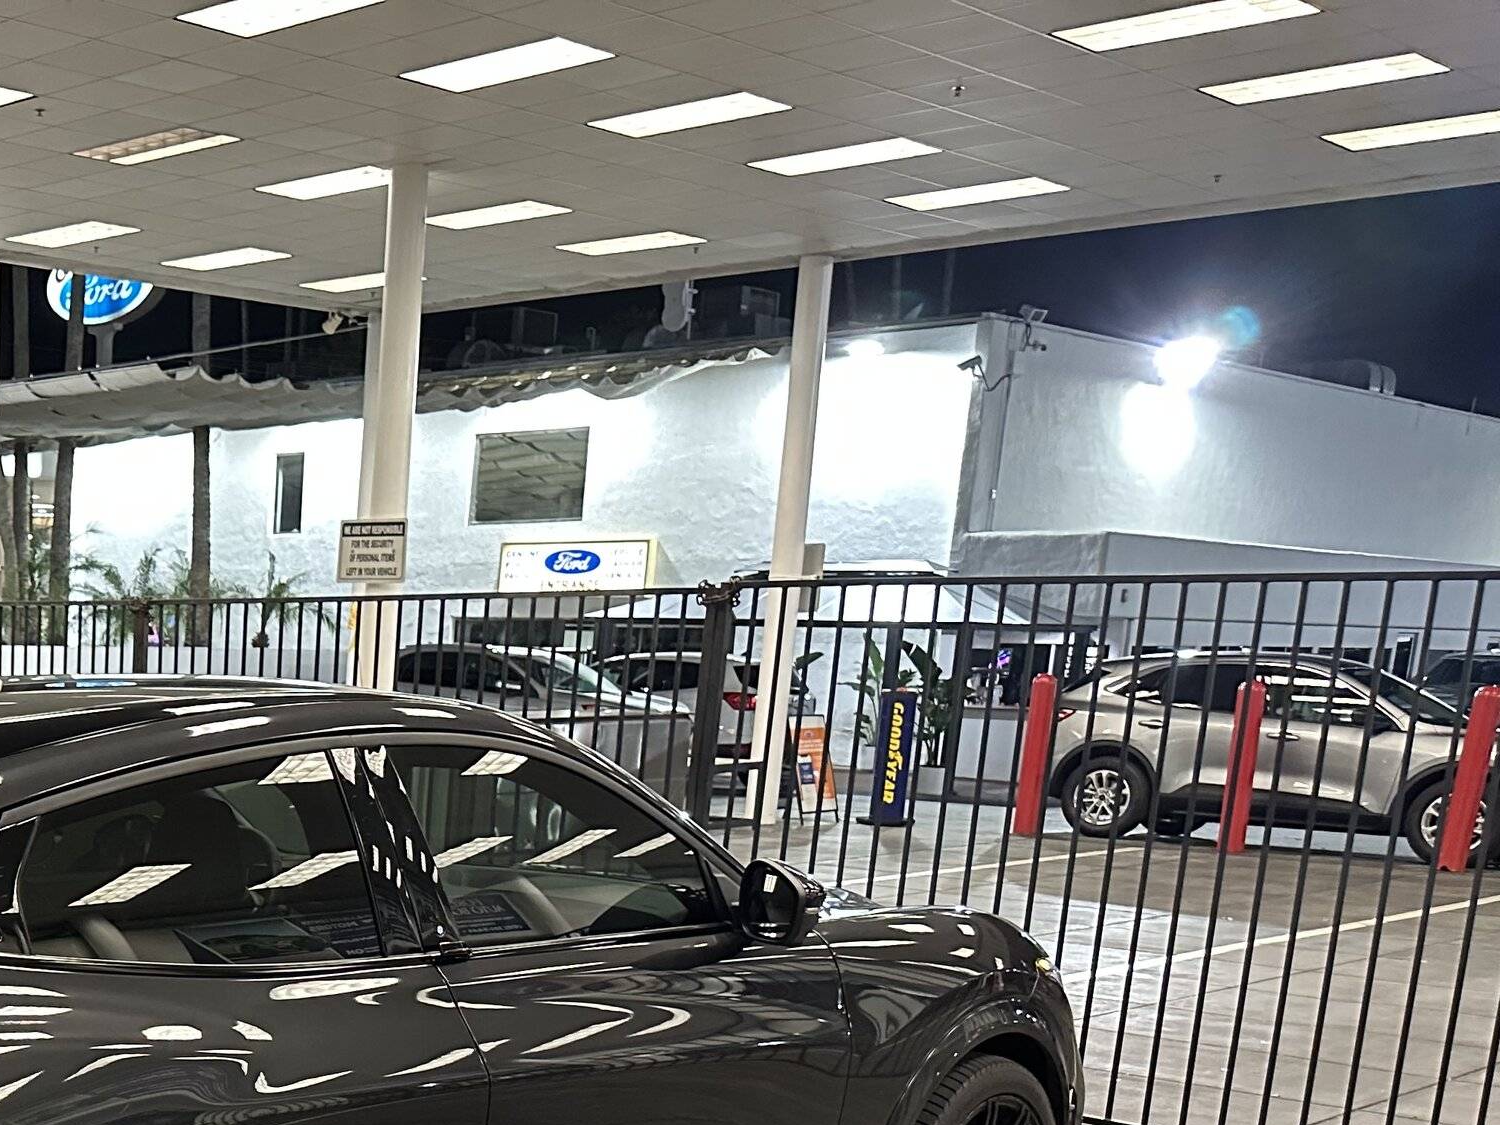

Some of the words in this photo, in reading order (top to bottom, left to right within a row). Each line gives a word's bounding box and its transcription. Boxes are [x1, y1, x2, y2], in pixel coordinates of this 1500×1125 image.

[351, 540, 360, 548] FOR
[362, 540, 370, 548] THE
[553, 551, 592, 571] Ford
[346, 567, 357, 576] LEFT
[364, 567, 376, 576] YOUR
[377, 567, 397, 576] VEHICLE
[882, 702, 905, 804] GOODYEAR
